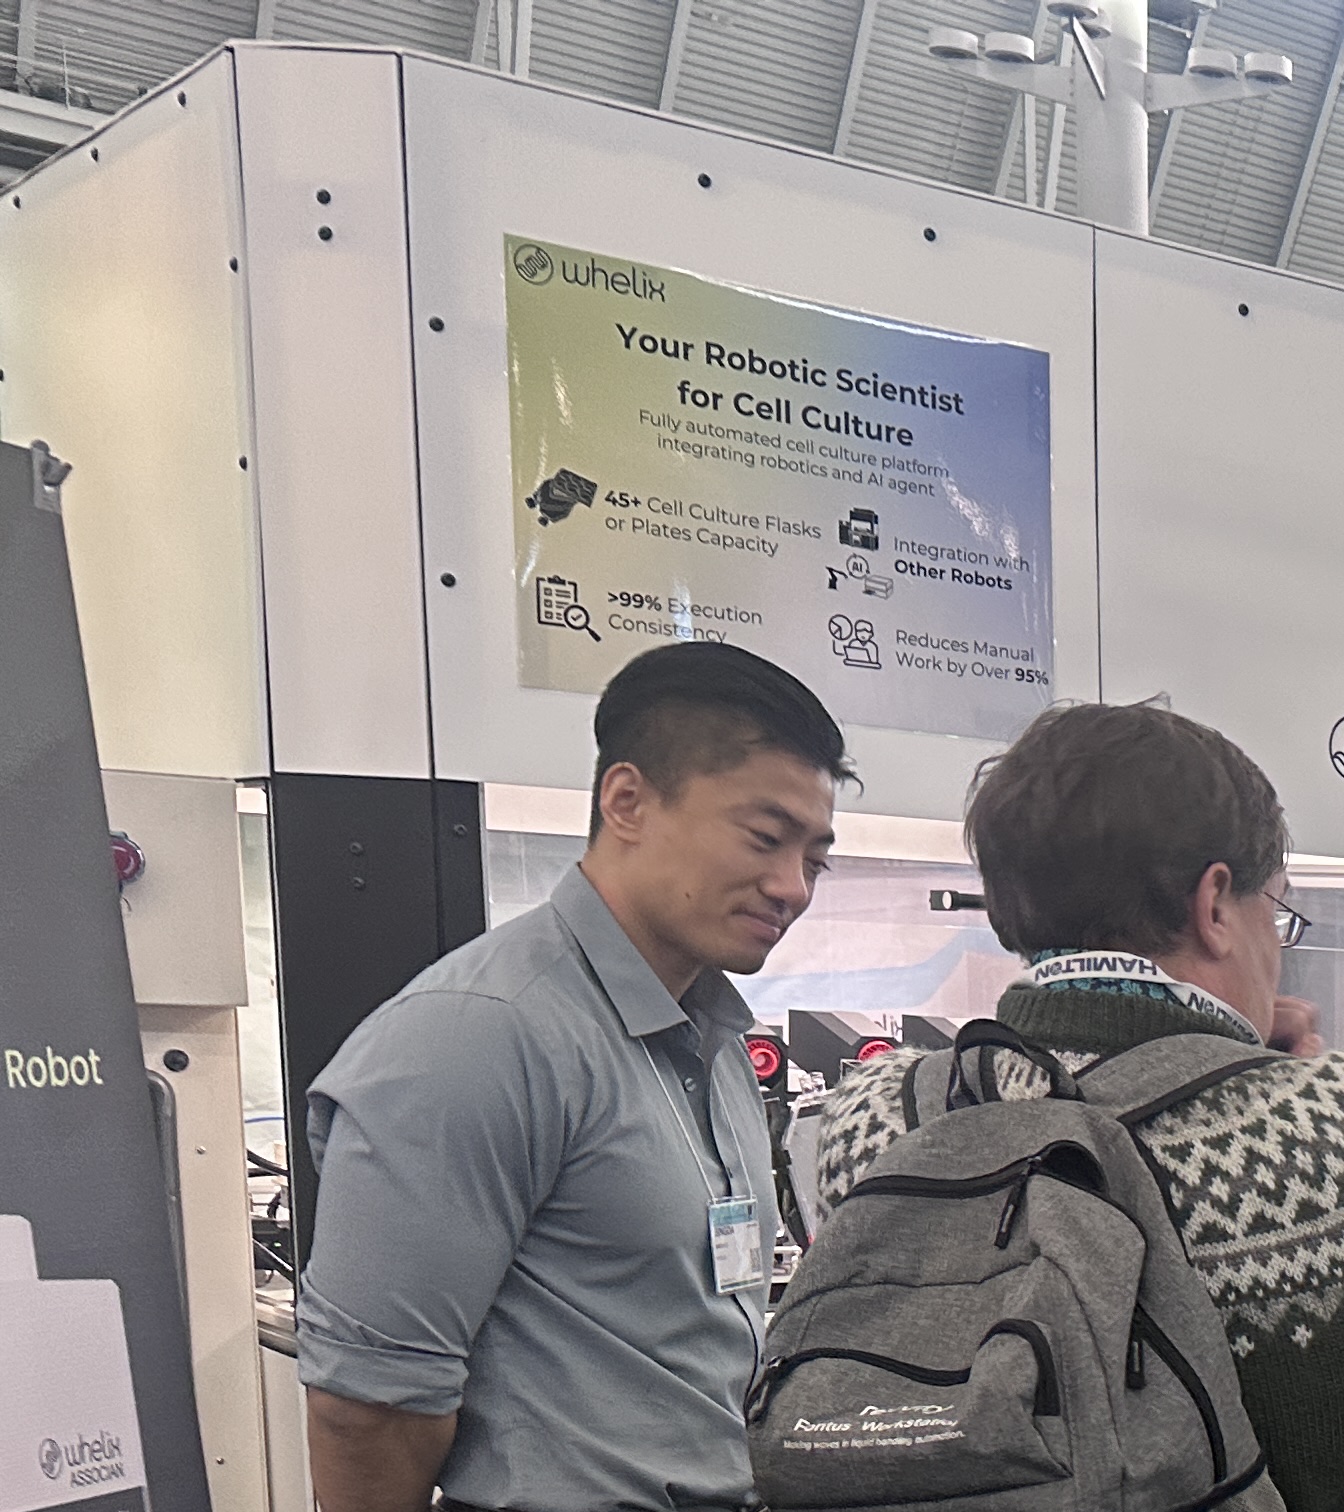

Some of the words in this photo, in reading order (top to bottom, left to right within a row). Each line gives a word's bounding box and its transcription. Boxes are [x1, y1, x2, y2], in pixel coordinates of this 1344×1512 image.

[562, 257, 666, 303] whelix
[615, 322, 696, 362] Your
[705, 341, 828, 388] Robotic
[836, 368, 965, 416] Scientist
[677, 380, 723, 412] for
[733, 392, 792, 425] Cell
[801, 404, 914, 447] Culture
[639, 408, 682, 434] Fully
[685, 416, 782, 450] automated
[786, 438, 815, 455] cell
[818, 443, 878, 467] culture
[881, 455, 950, 479] platform
[657, 433, 755, 467] integrating
[760, 453, 828, 478] robotics
[831, 467, 863, 485] and
[867, 472, 884, 487] AI
[888, 479, 936, 498] agent
[604, 490, 642, 509] 45+
[647, 496, 683, 517] Cell
[689, 503, 761, 530] Culture
[765, 515, 823, 540] Flasks
[605, 516, 626, 532] or
[632, 517, 692, 542] Plates
[696, 527, 779, 558] Capacity
[893, 536, 990, 566] Integration
[994, 552, 1031, 573] with
[893, 559, 947, 581] Other
[951, 568, 1013, 591] Robots
[607, 591, 662, 613] >99%
[667, 598, 763, 626] Execution
[608, 613, 727, 644] Consistency
[895, 629, 970, 655] Reduces
[973, 639, 1035, 663] Manual
[895, 651, 943, 672] Work
[946, 658, 968, 678] by
[971, 661, 1011, 680] Over
[1014, 666, 1050, 686] 95%
[4, 1046, 104, 1090] Robot
